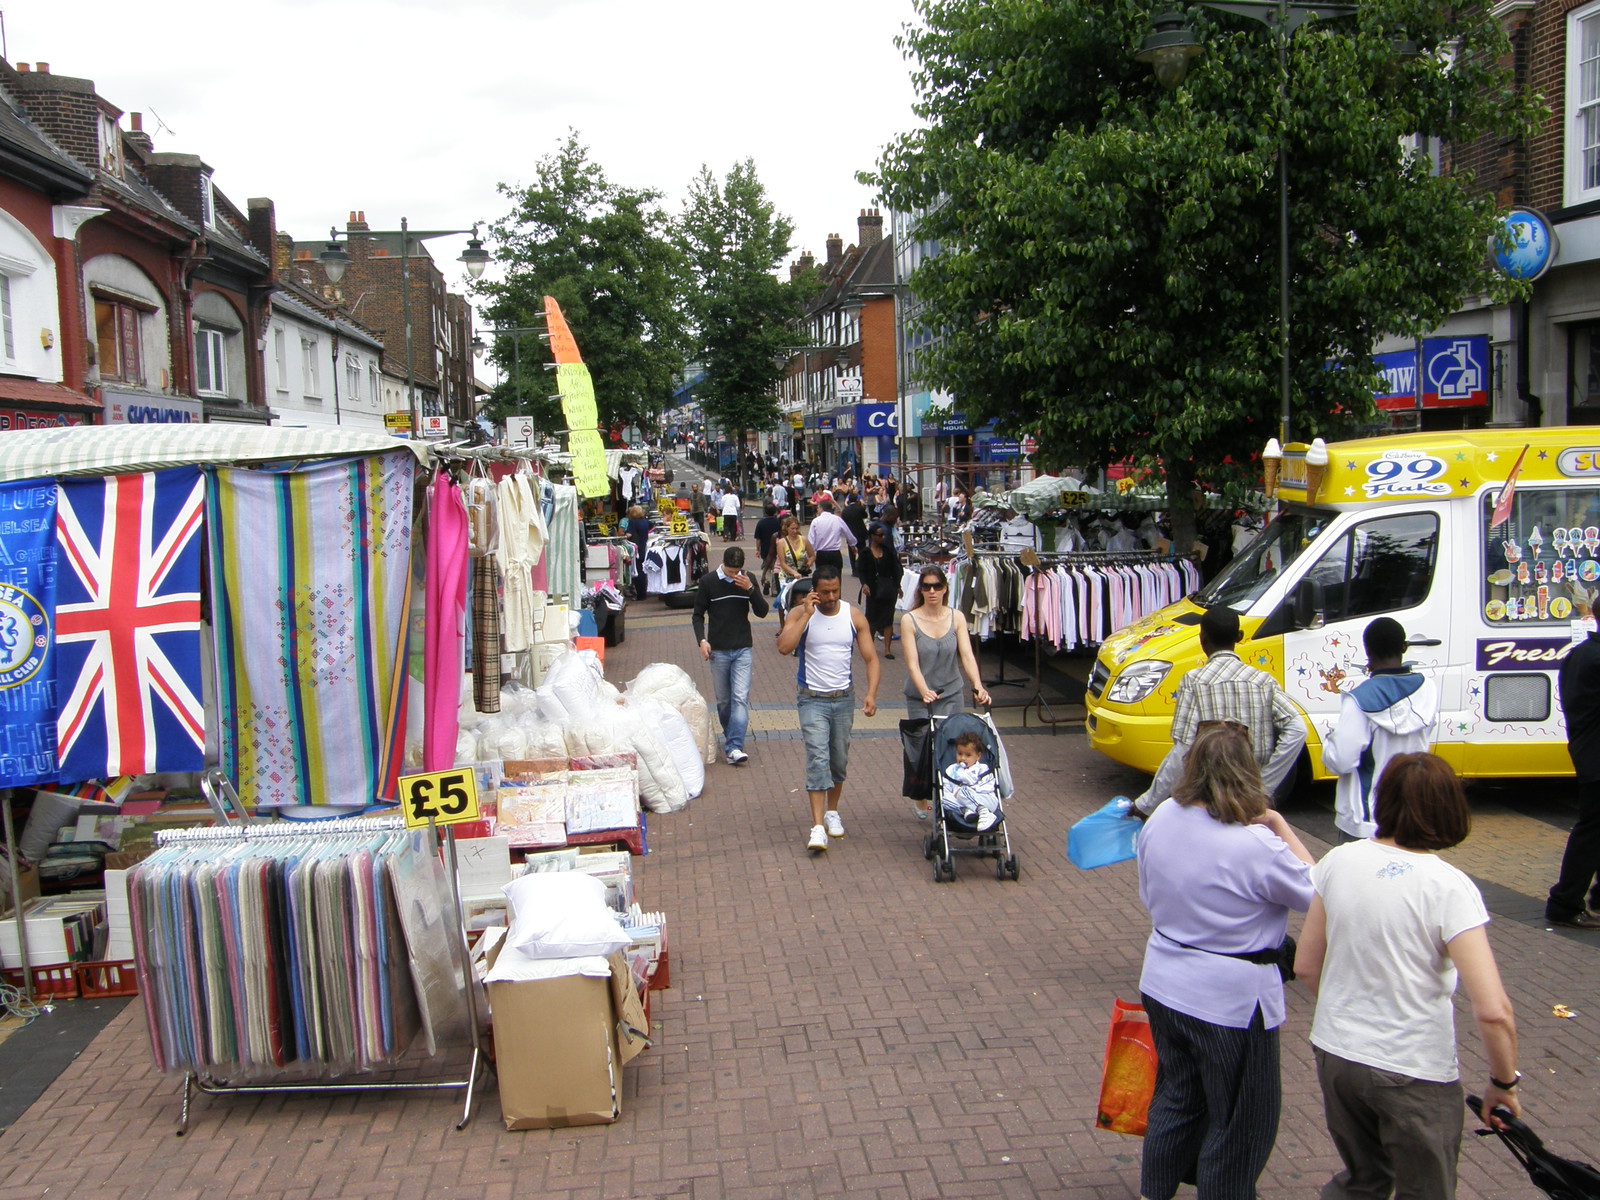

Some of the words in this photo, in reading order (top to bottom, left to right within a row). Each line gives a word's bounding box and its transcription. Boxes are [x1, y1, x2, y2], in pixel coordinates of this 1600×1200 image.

[1385, 451, 1421, 460] Cadbury
[1368, 459, 1442, 482] 99
[1365, 481, 1447, 495] Flake
[1062, 492, 1086, 504] £25
[605, 514, 616, 522] £5
[673, 523, 687, 533] £2
[14, 656, 39, 679] CLUB
[410, 775, 469, 820] £5
